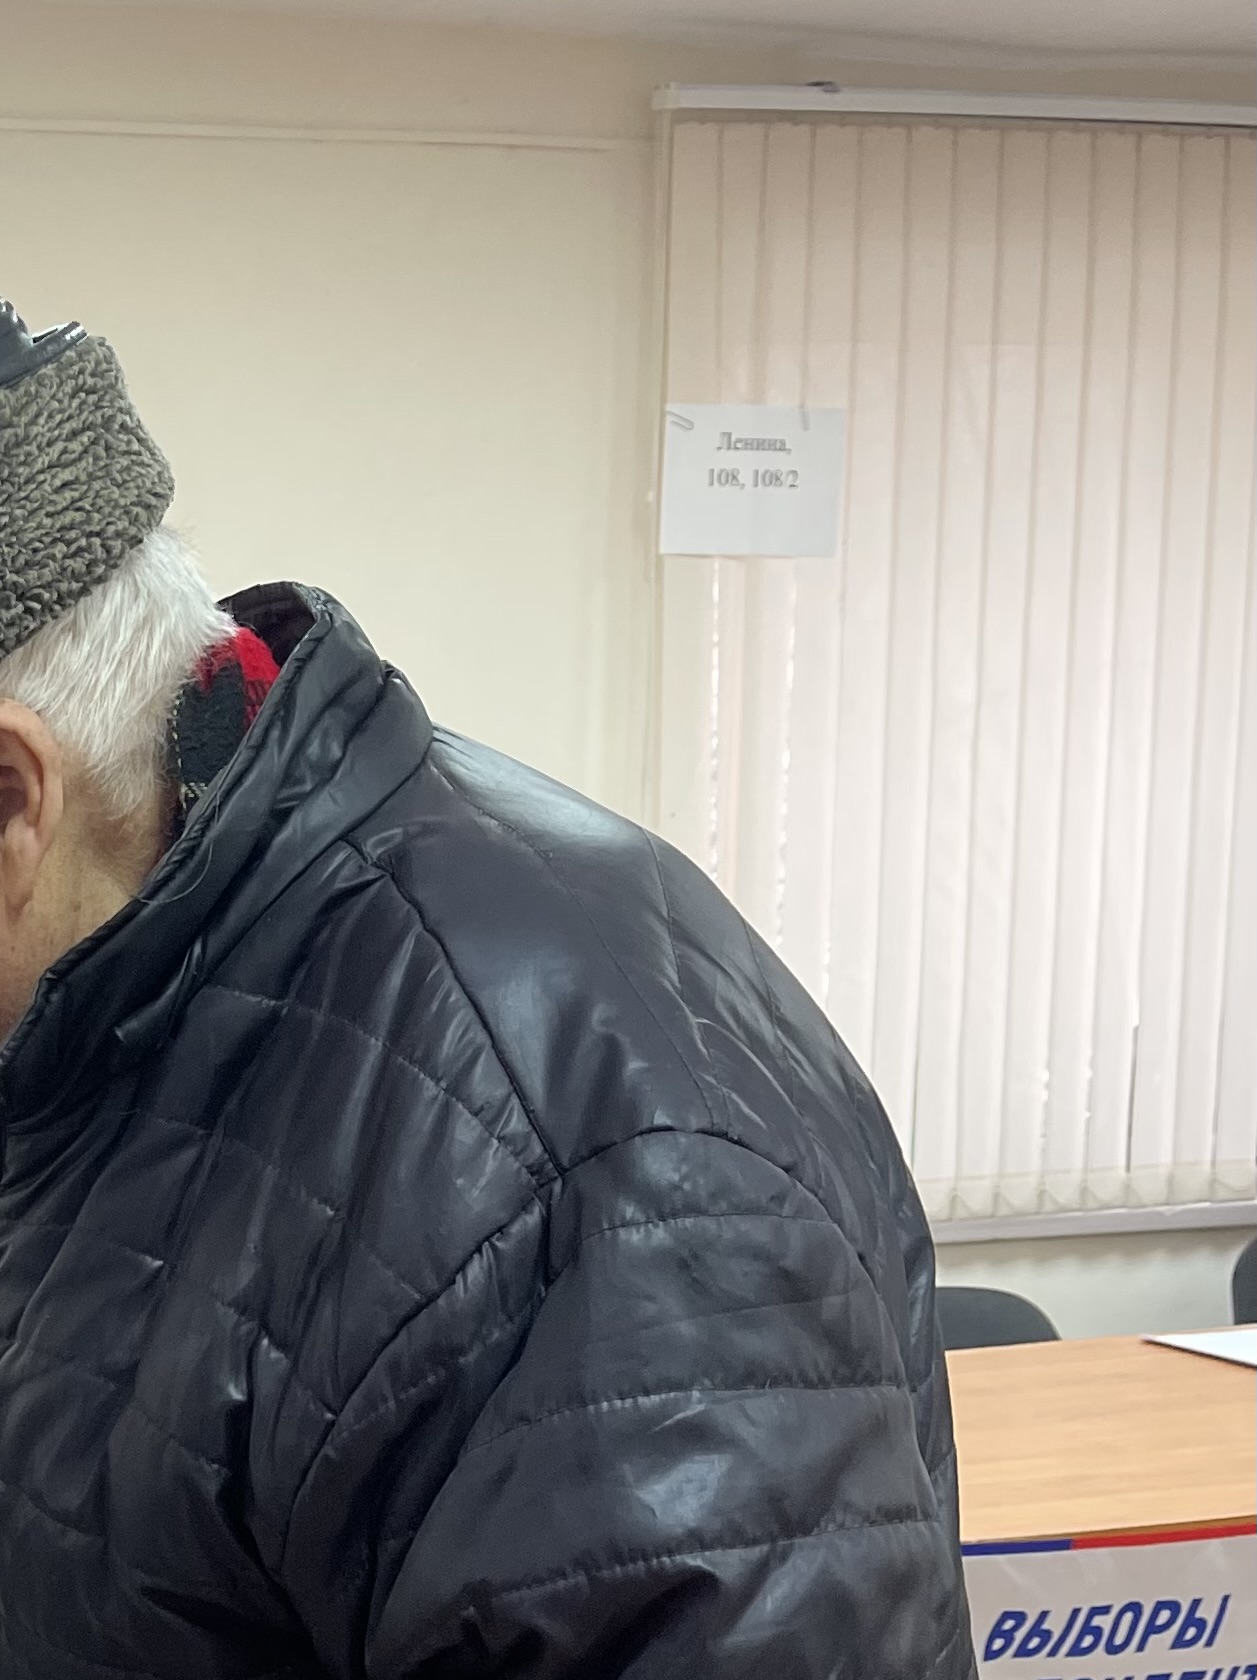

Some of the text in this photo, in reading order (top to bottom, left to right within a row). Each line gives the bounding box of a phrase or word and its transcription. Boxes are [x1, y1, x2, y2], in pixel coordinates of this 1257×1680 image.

[715, 431, 793, 456] Ленина,
[707, 467, 746, 491] 108,
[982, 1593, 1231, 1662] ВЫБОРЫ
